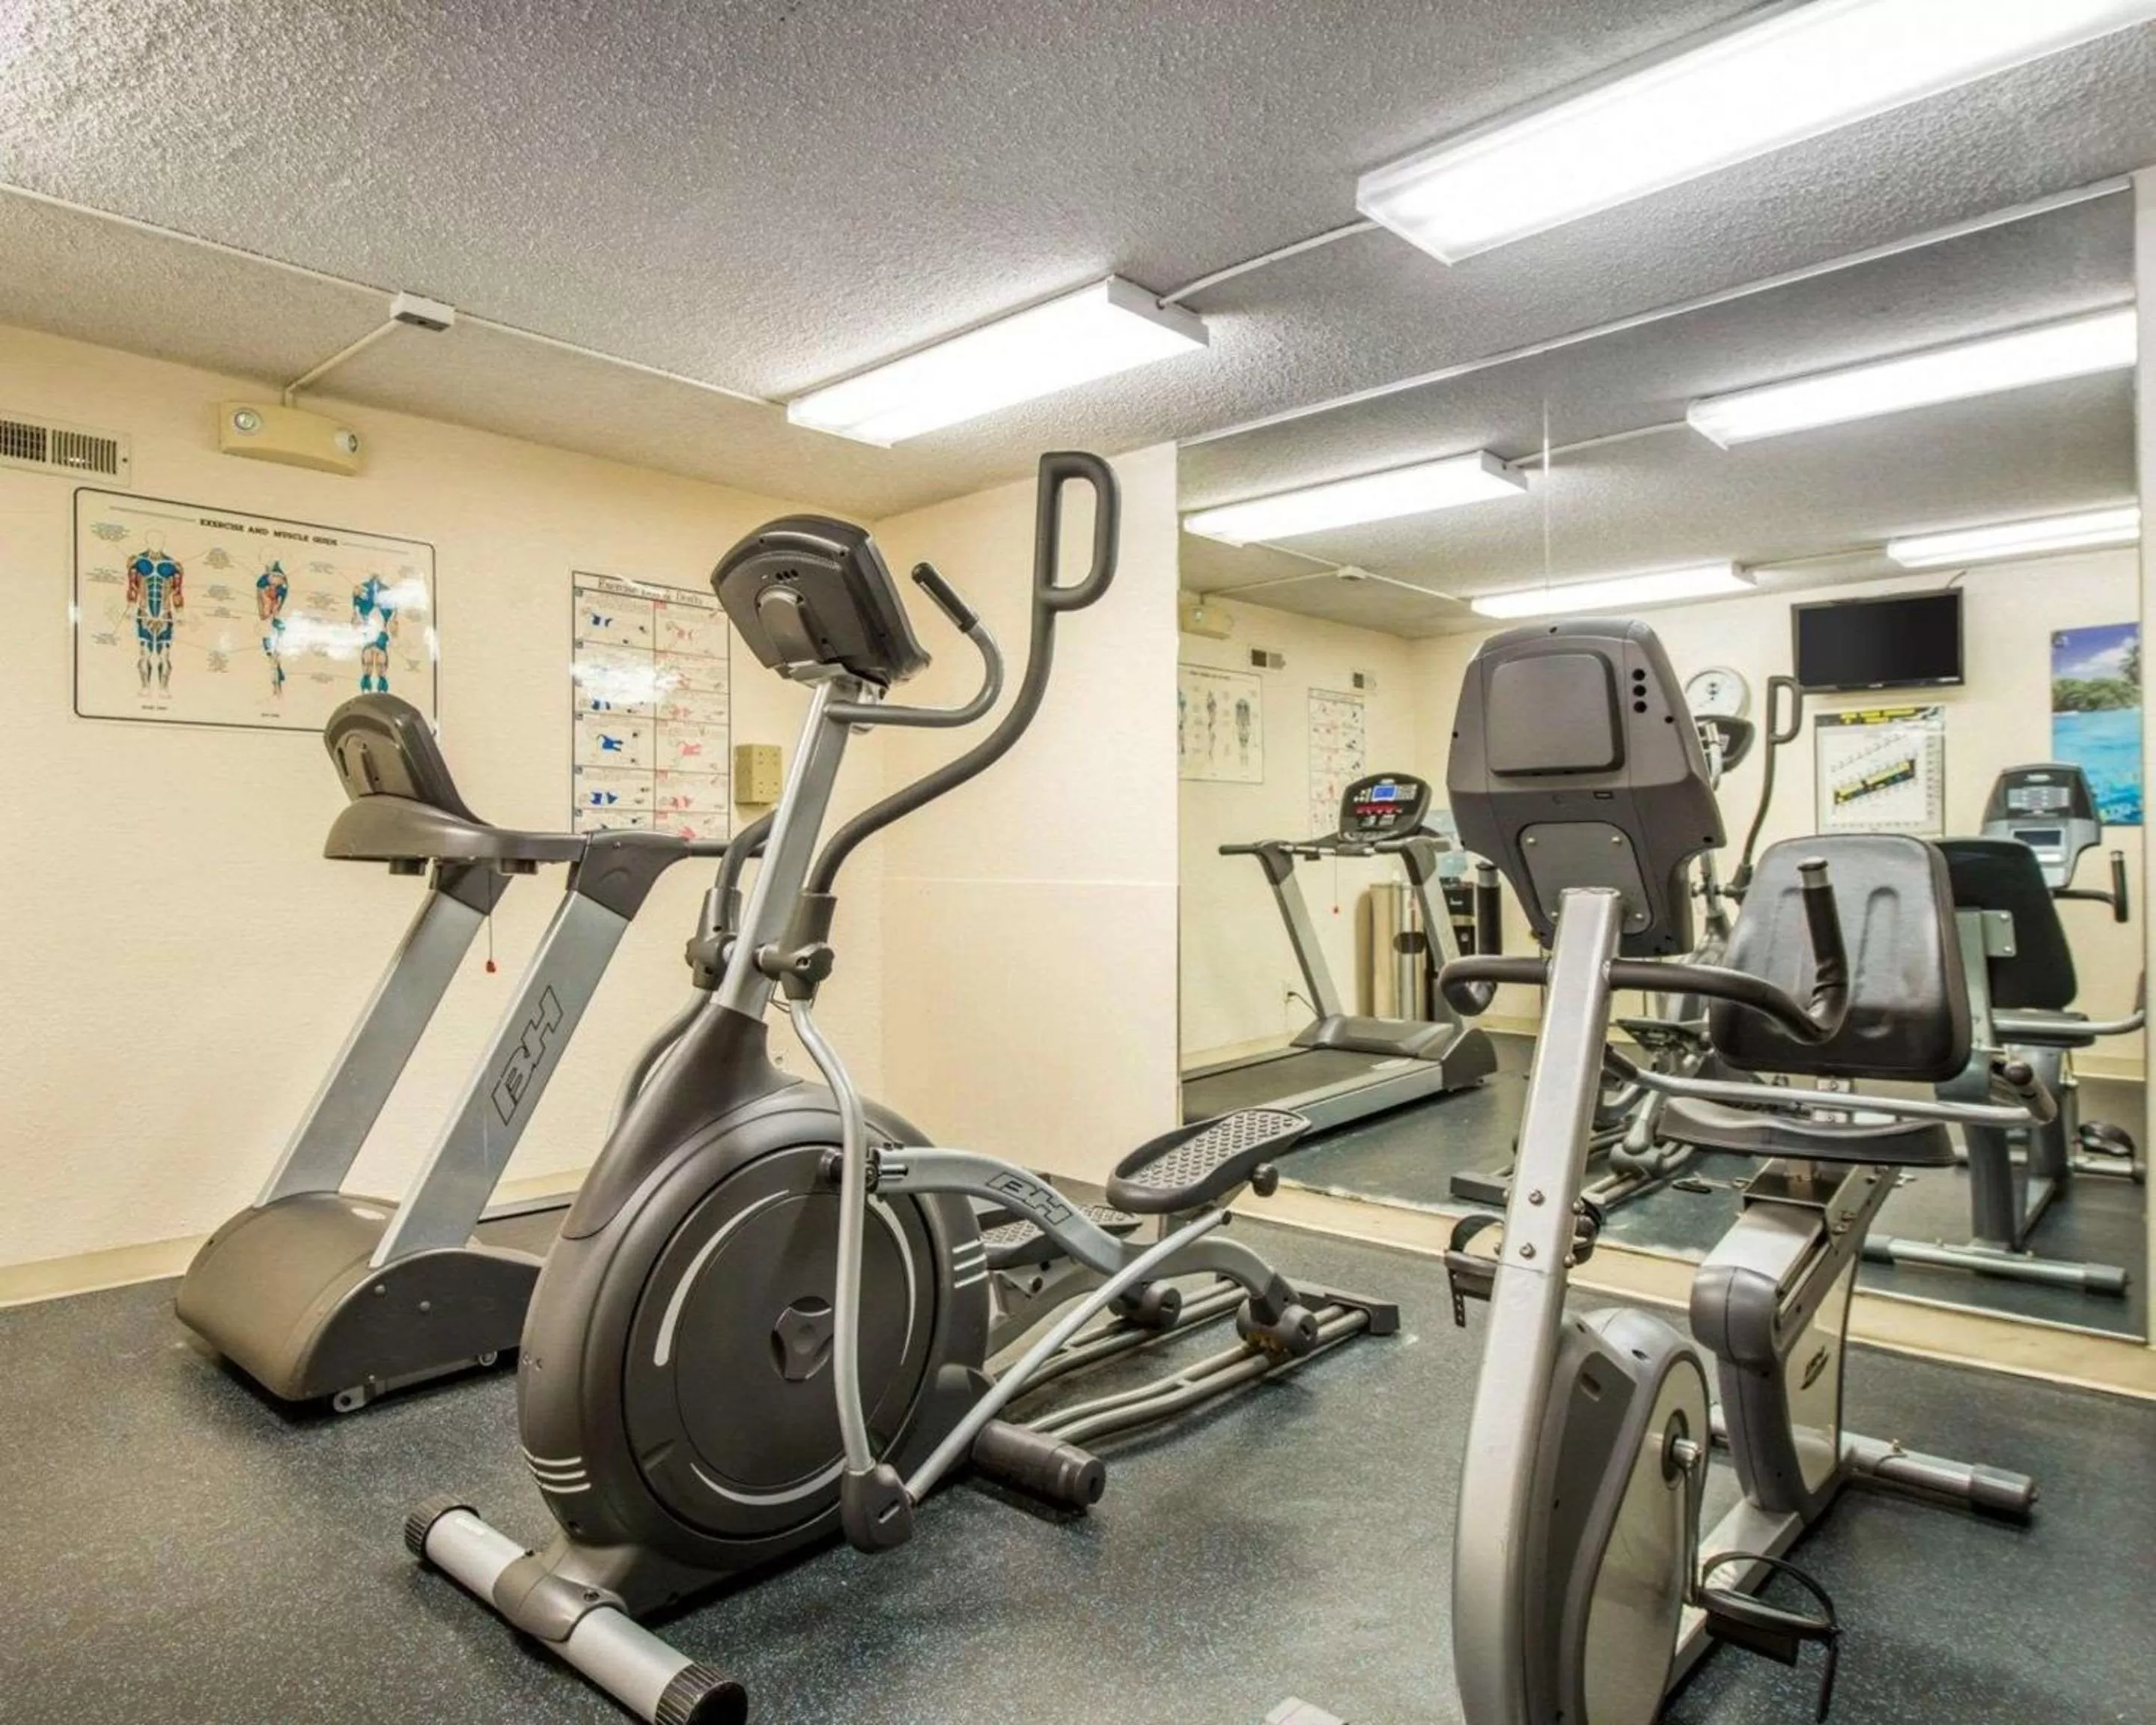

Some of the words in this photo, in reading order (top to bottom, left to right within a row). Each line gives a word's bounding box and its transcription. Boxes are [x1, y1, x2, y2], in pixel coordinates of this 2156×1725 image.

[200, 518, 244, 532] EXERCISE
[248, 526, 269, 535] AND
[273, 530, 309, 541] MUSCLE
[491, 985, 564, 1126] BH
[986, 1171, 1074, 1225] BH
